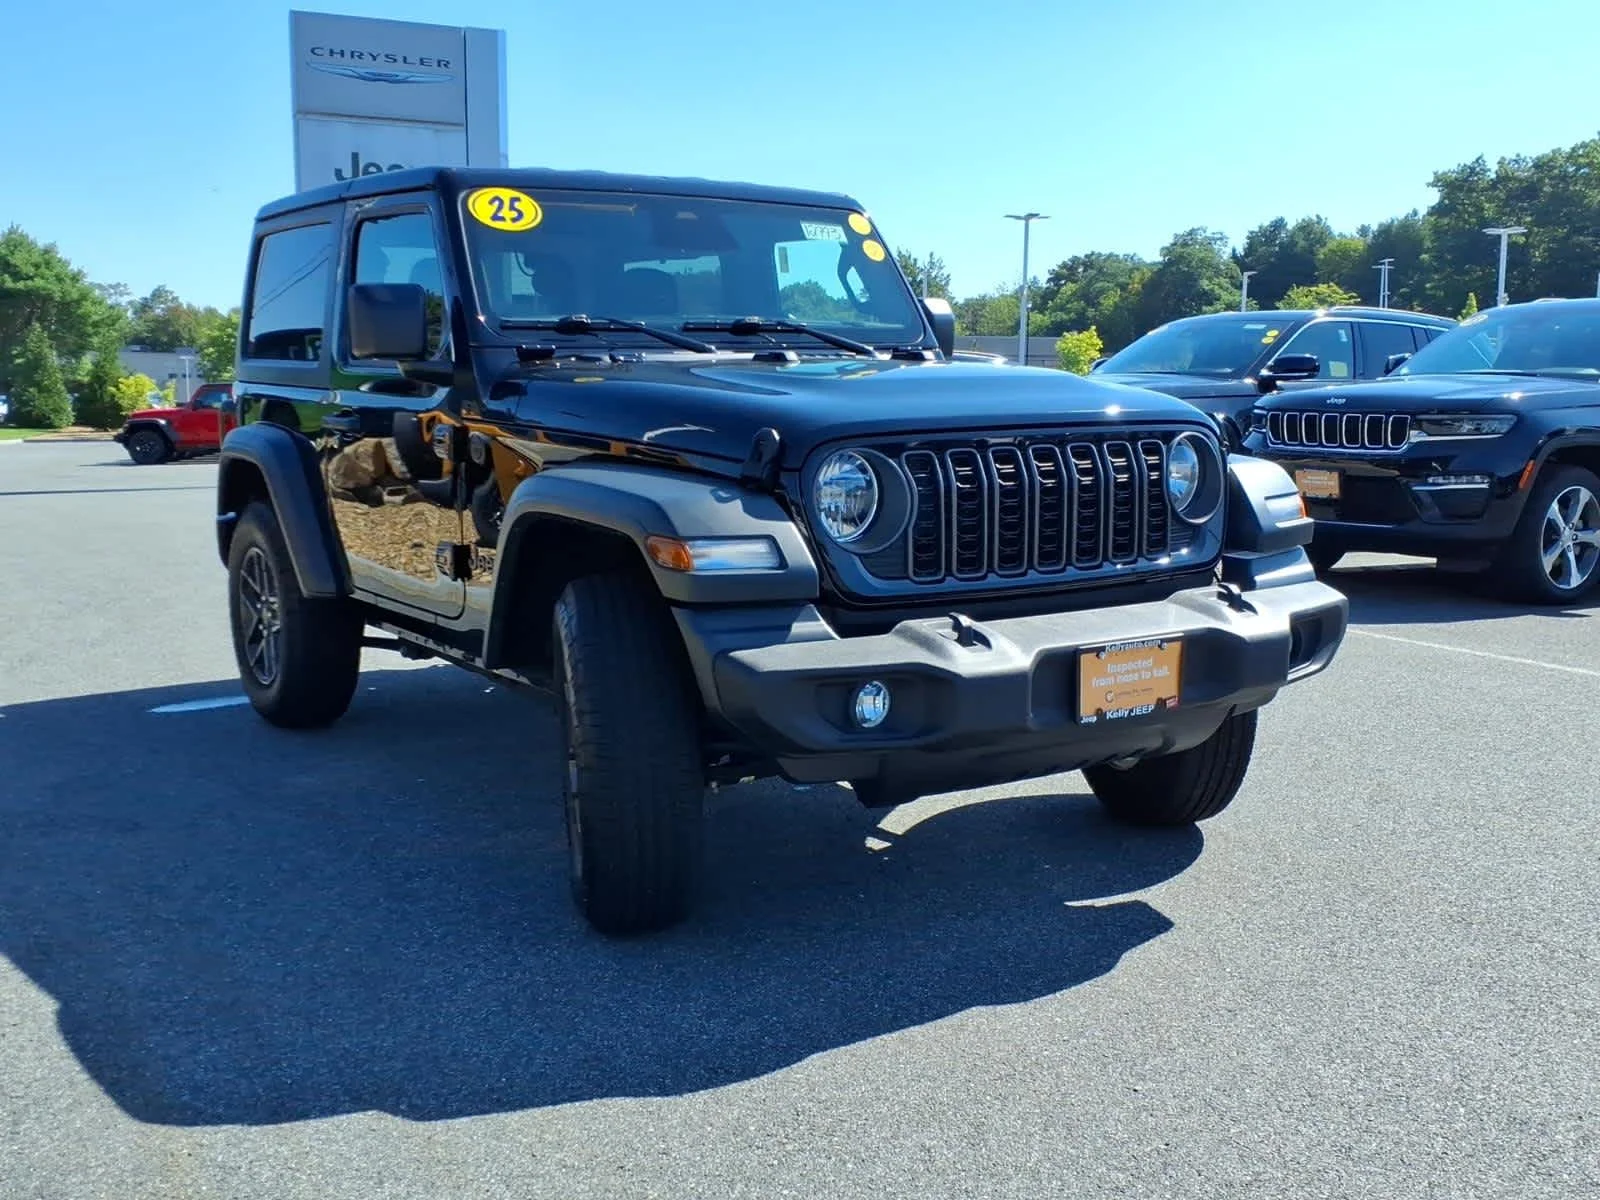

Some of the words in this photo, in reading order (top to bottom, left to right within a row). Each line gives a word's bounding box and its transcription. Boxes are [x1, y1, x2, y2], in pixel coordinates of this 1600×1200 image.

[310, 46, 453, 69] CHRYSLER
[487, 196, 525, 223] 25
[1108, 657, 1153, 673] Inspected
[1093, 677, 1114, 687] from
[1118, 674, 1139, 683] nose
[1142, 670, 1152, 679] to
[1080, 715, 1097, 724] Jeep
[1106, 708, 1130, 720] Kelly
[1130, 704, 1154, 716] JEEP
